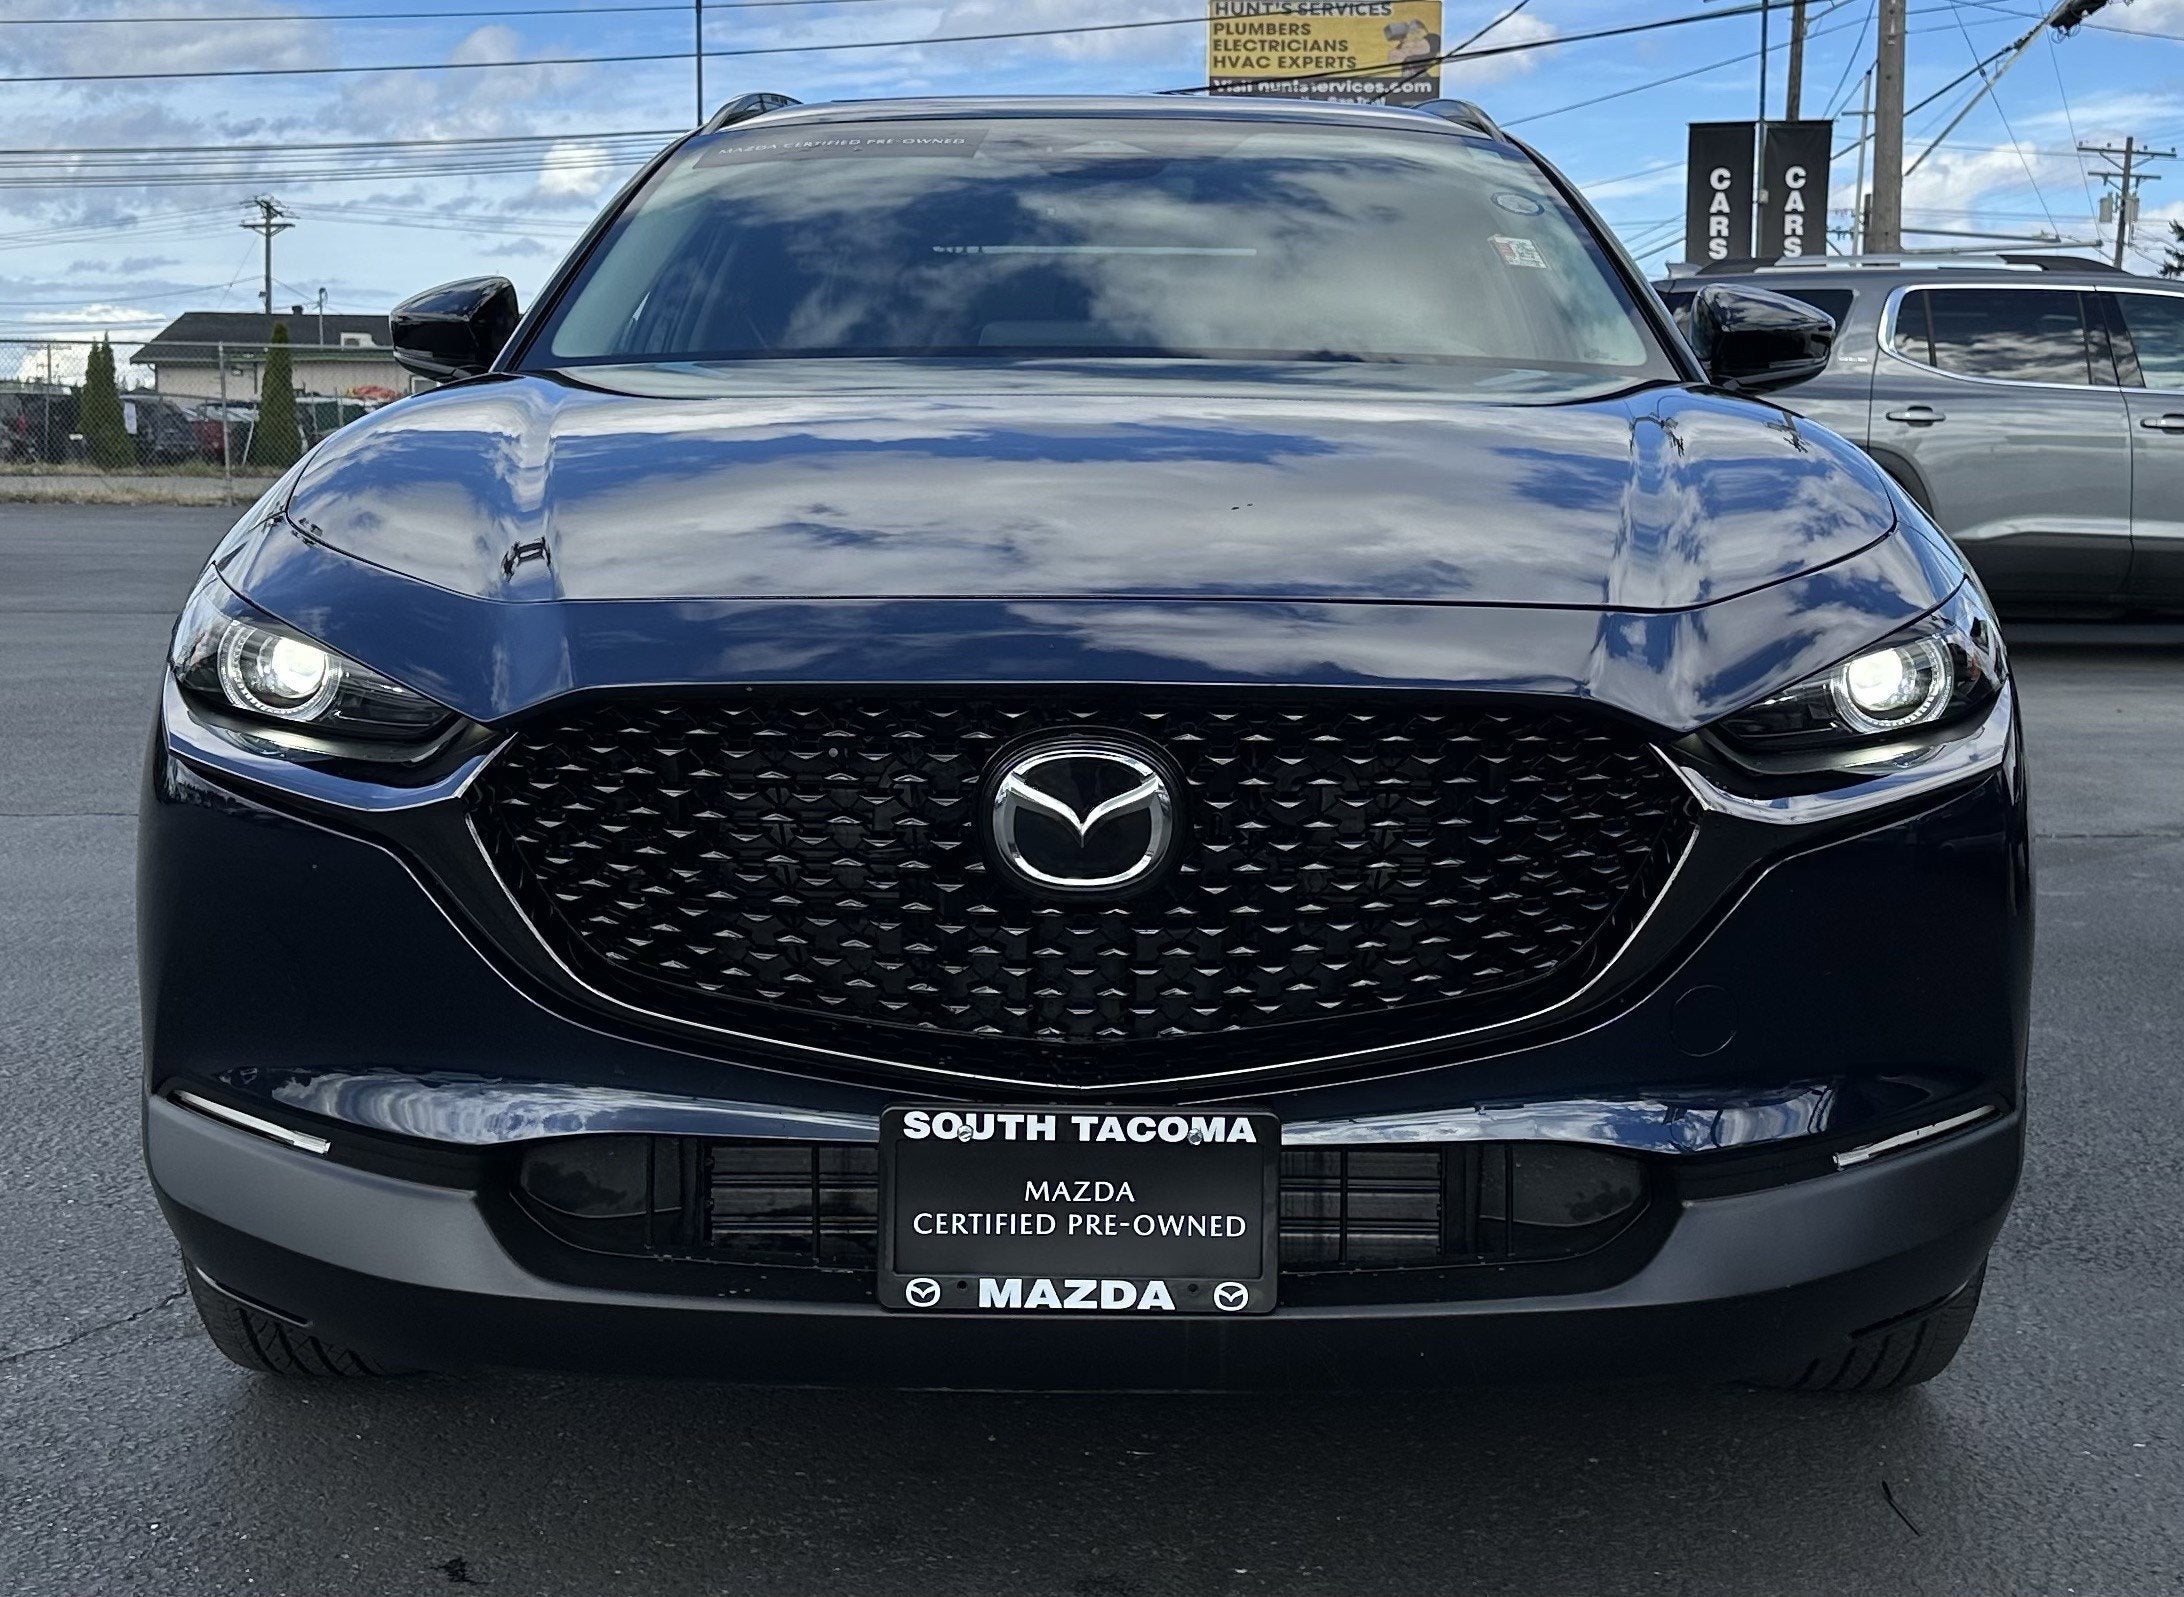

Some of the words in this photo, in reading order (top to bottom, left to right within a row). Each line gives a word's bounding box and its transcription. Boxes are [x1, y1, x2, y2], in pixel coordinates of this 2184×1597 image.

[1215, 1, 1292, 16] HUNT'S
[1298, 2, 1393, 17] SERVICES
[1213, 22, 1312, 36] PLUMBERS
[1213, 38, 1349, 53] ELECTRICIANS
[1213, 55, 1271, 69] HVAC
[1277, 55, 1358, 69] EXPERTS
[718, 144, 777, 154] MAZDA
[784, 138, 862, 149] CERTIFIED
[1708, 167, 1732, 260] CARS
[1783, 165, 1807, 258] CARS
[903, 1110, 1057, 1142] SOUTH
[1071, 1115, 1257, 1143] TACOMA
[1024, 1181, 1135, 1203] MAZDA
[913, 1212, 1056, 1235] CERTIFIED
[1068, 1214, 1247, 1238] PRE-OWNED
[978, 1277, 1176, 1311] MAZDA
